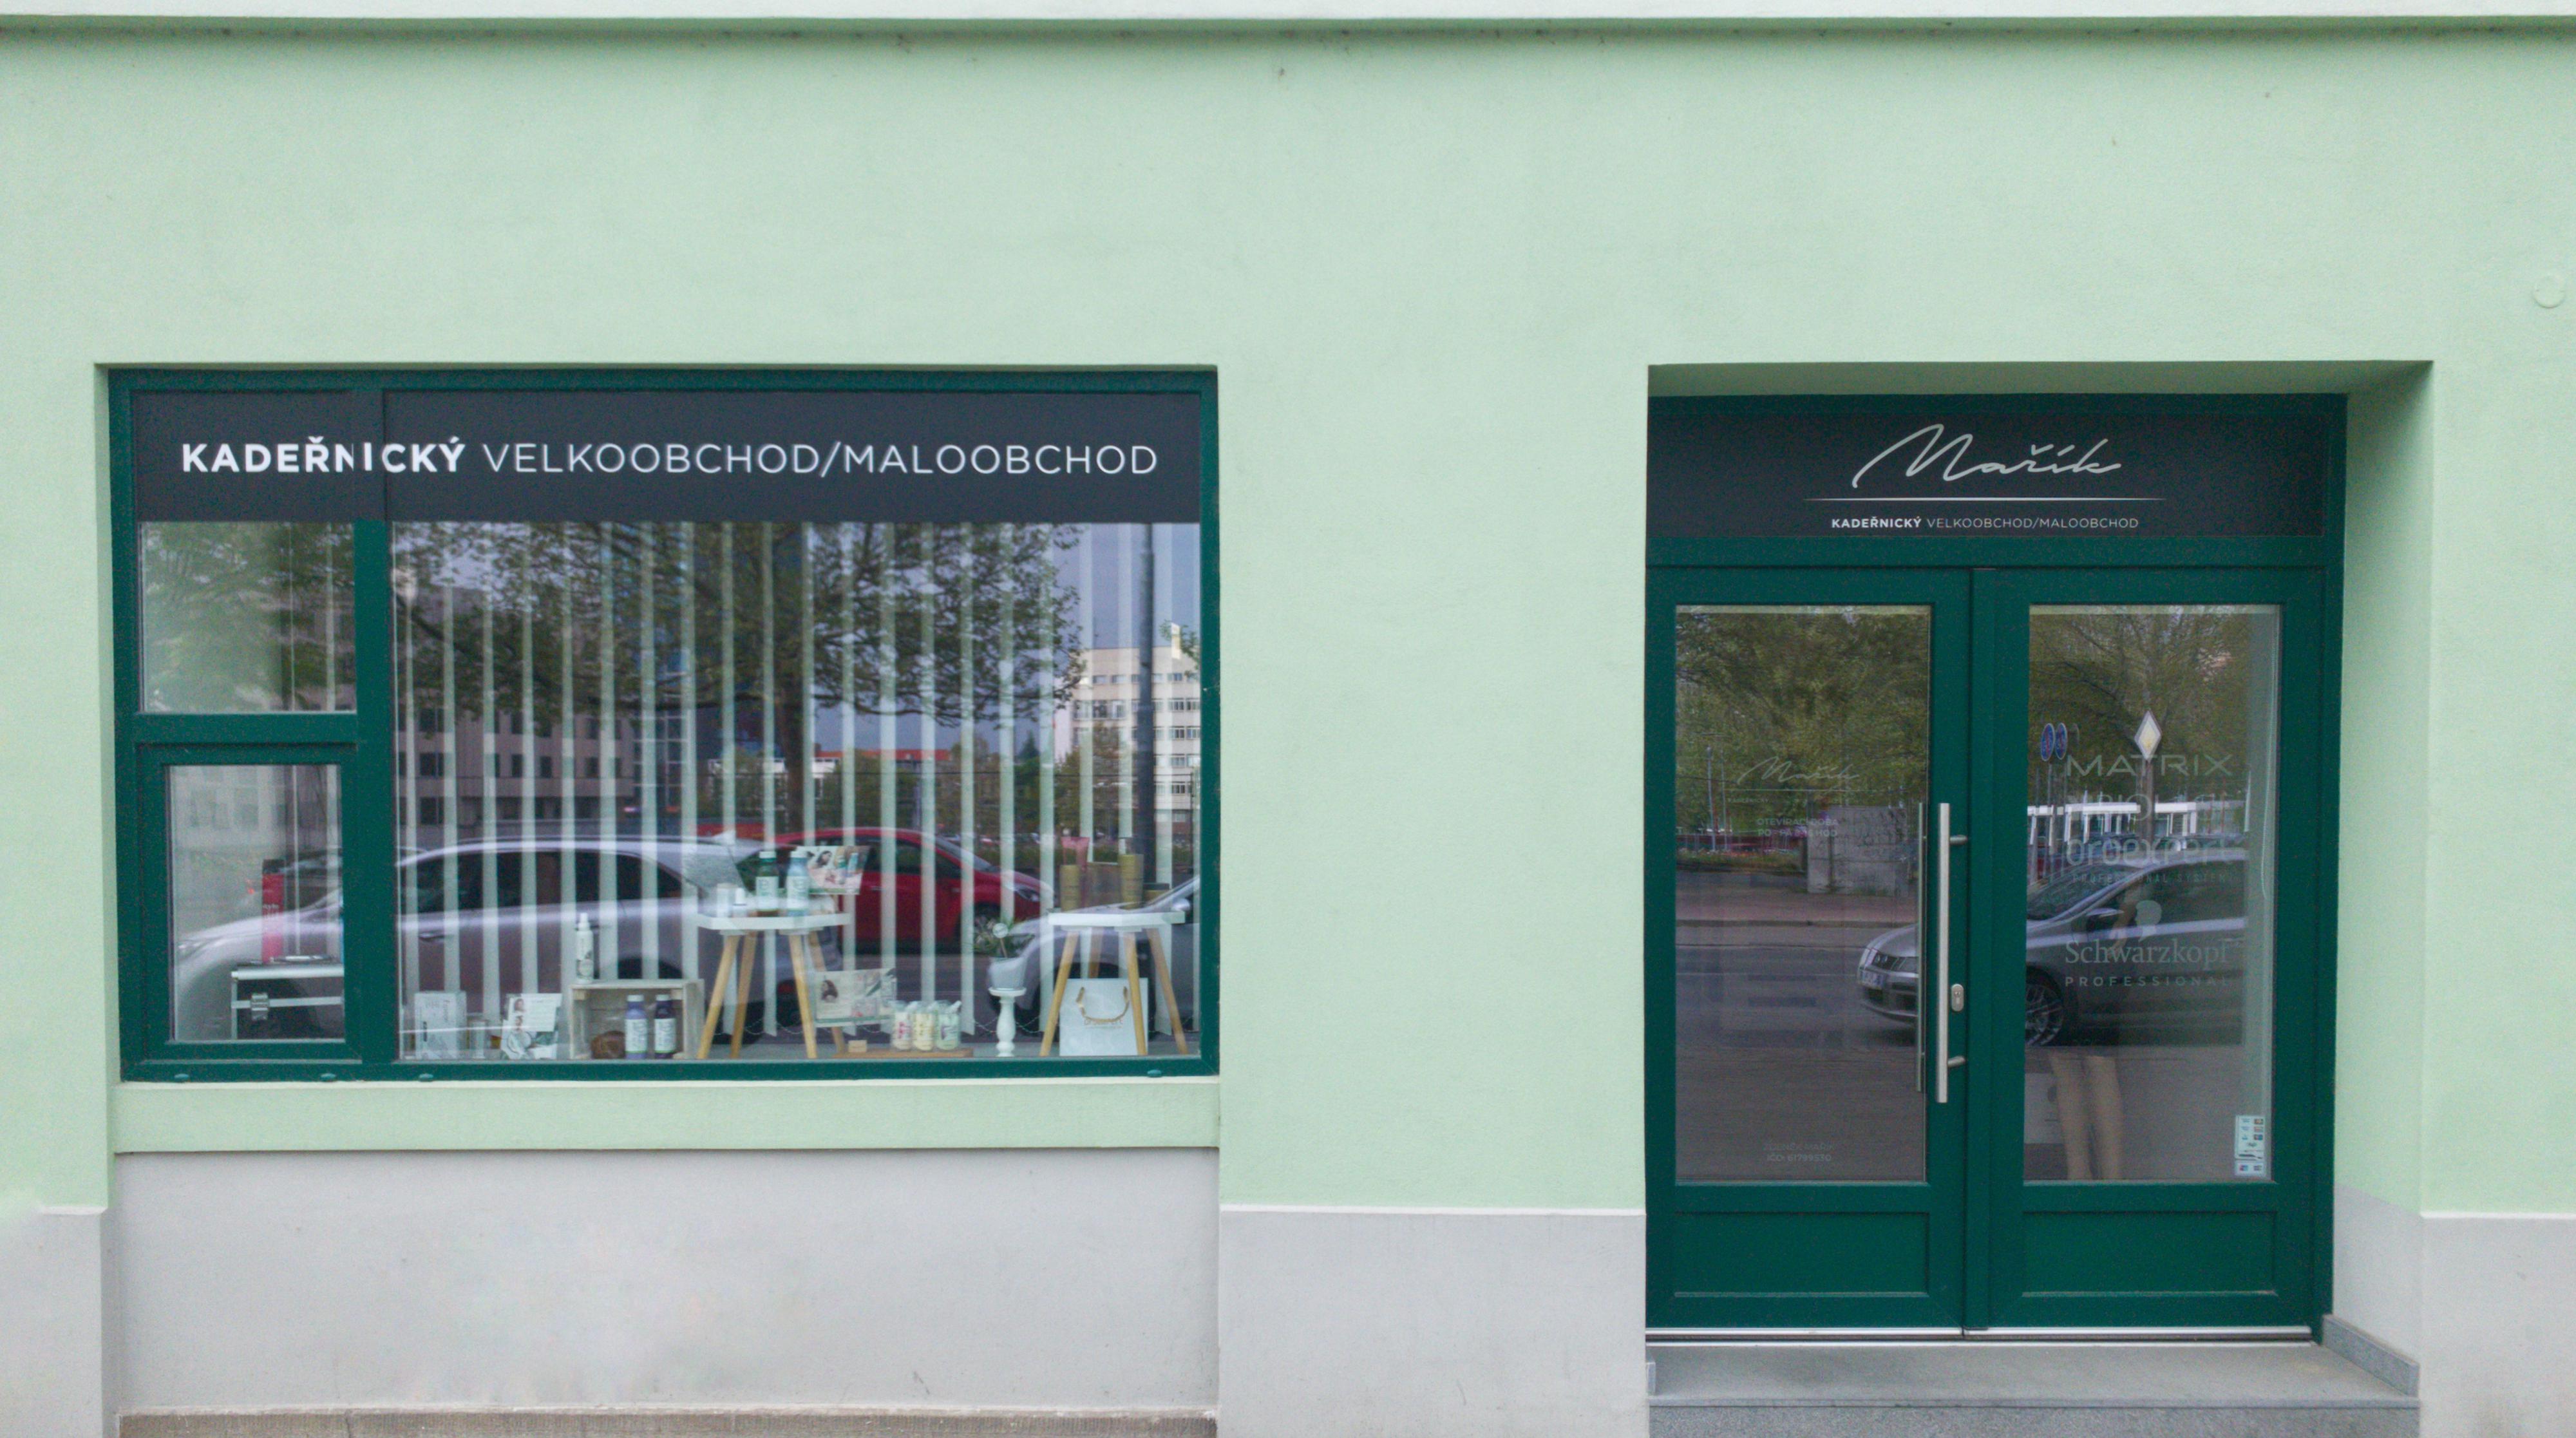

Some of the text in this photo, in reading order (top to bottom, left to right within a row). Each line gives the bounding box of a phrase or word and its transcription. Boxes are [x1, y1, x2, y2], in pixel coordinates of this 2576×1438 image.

[182, 435, 1157, 478] KADEŘNICKÝ VELKOOBCHOD/MALOOBCHOD
[1852, 423, 2121, 488] Mařík
[1832, 516, 2139, 530] KADEŘNICKÝ VELKOOBCHOD/MALOOBCHOD
[2067, 753, 2233, 777] MATRIX
[2065, 938, 2233, 971] Schwarzkopf
[2065, 976, 2229, 987] PROFESSIONAL
